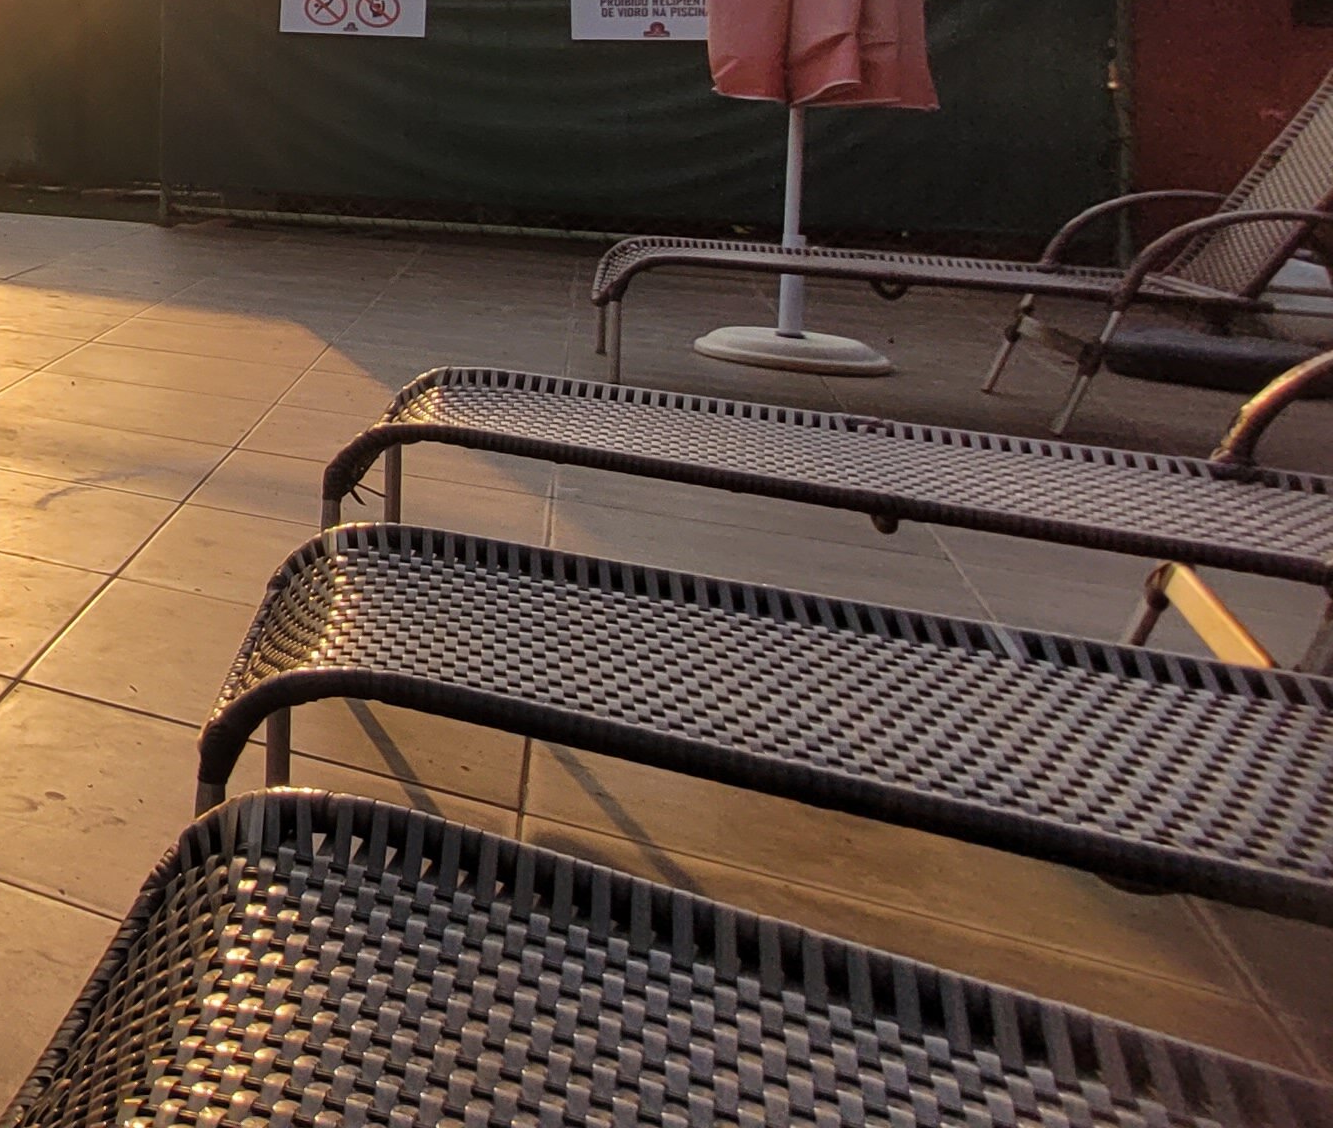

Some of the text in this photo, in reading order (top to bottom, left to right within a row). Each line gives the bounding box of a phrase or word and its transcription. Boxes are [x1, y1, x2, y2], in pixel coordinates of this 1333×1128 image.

[601, 7, 614, 18] DE
[617, 7, 649, 18] VIDRO
[652, 7, 667, 17] NA
